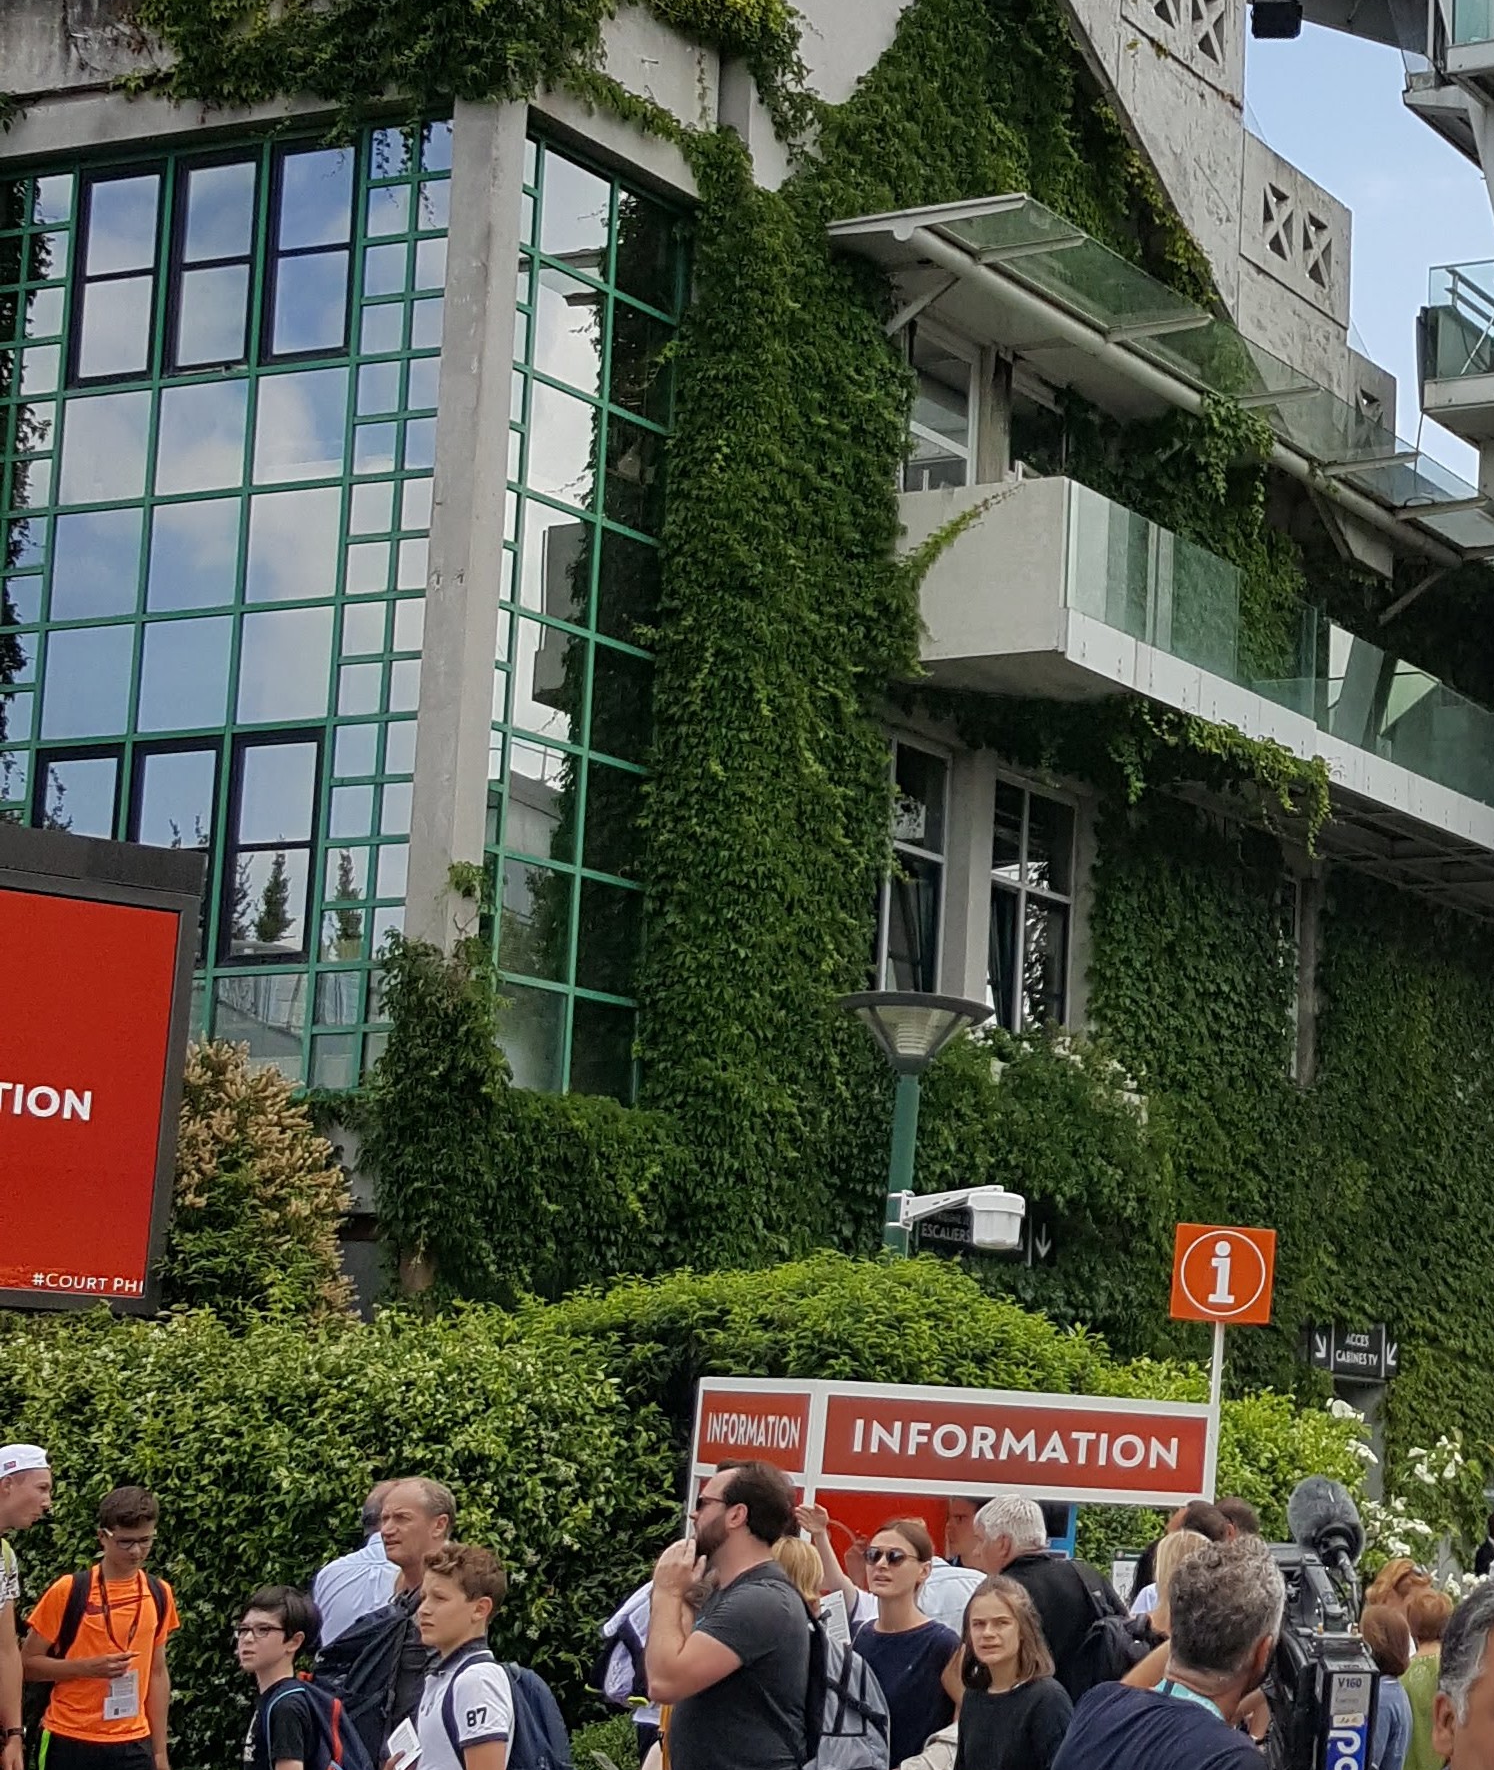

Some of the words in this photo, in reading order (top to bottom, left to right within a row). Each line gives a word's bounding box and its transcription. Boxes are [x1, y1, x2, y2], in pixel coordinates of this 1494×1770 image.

[32, 1272, 108, 1291] #COURT
[1336, 1350, 1367, 1365] CABINES
[1368, 1353, 1378, 1365] TV
[706, 1411, 801, 1449] INFORMATION
[852, 1418, 1178, 1470] INFORMATION
[467, 1707, 487, 1727] 87
